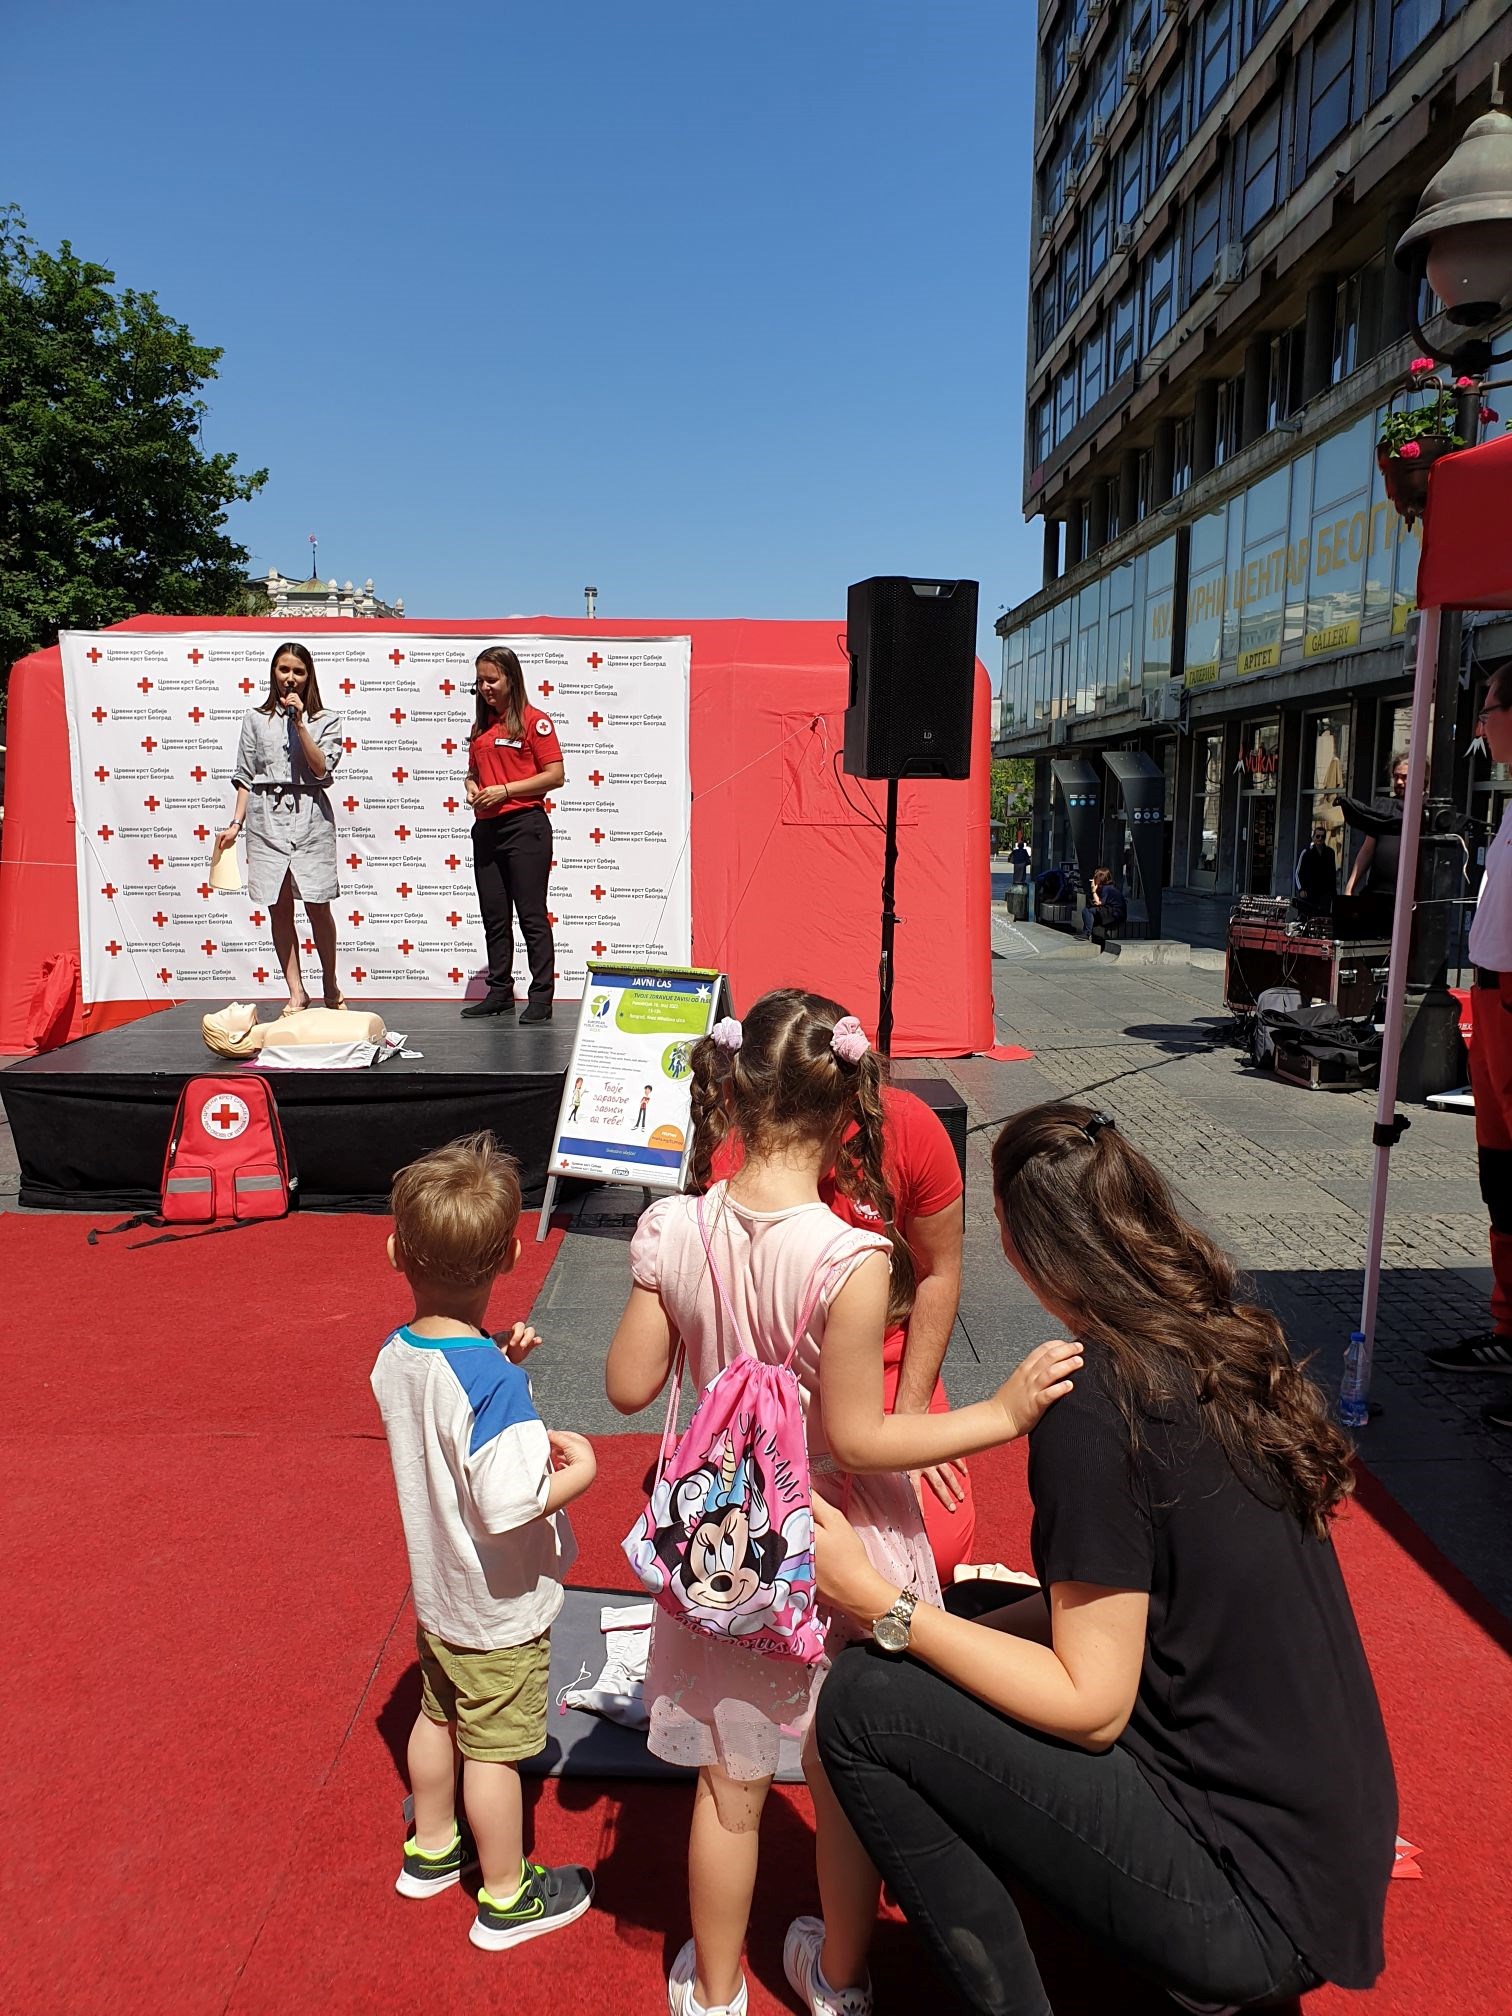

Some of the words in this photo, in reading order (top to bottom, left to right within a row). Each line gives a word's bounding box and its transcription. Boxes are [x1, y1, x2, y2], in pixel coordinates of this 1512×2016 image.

[1312, 626, 1350, 651] GALLERY
[632, 978, 654, 987] JAVNI
[657, 978, 672, 988] ČAS
[604, 1082, 623, 1094] Твоје
[593, 1094, 629, 1104] здравље
